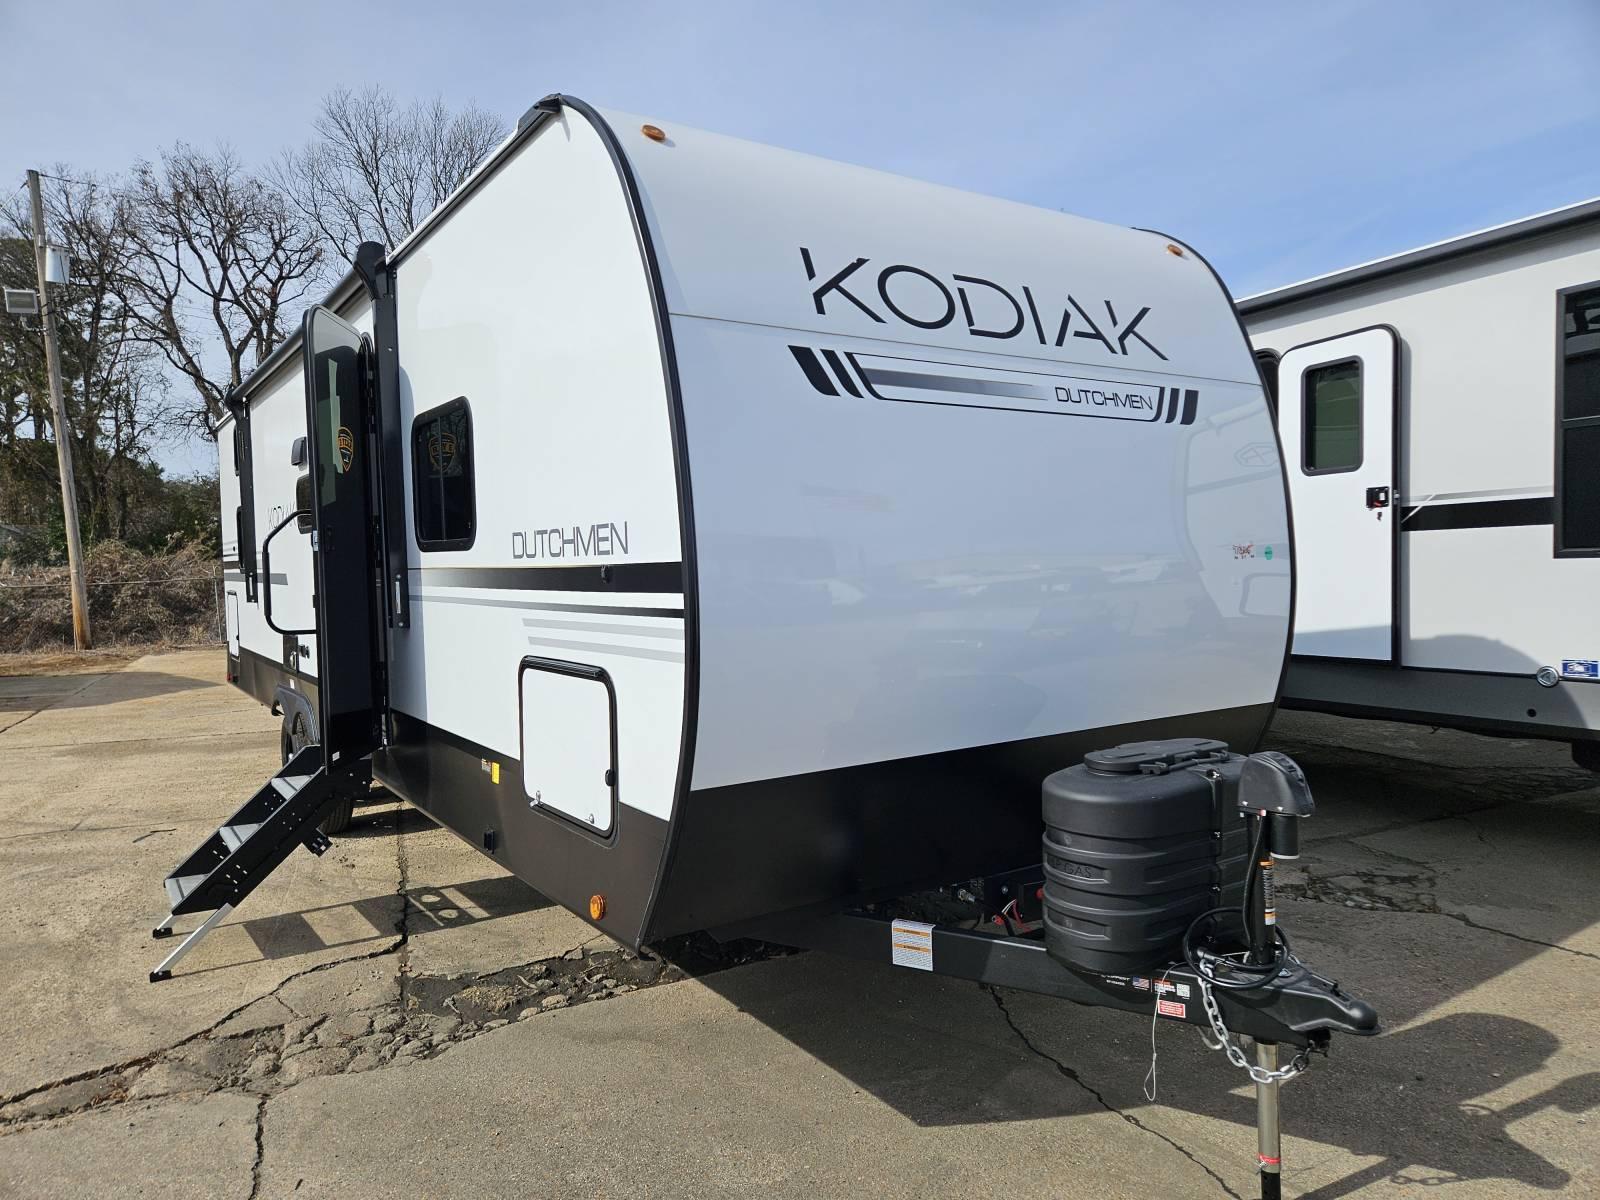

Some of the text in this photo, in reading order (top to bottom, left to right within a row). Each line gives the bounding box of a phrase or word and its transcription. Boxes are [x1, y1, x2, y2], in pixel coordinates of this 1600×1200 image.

[800, 247, 1169, 361] KODIAK
[1055, 386, 1153, 411] DUTCHMEN
[512, 521, 628, 559] DUTCHMEN
